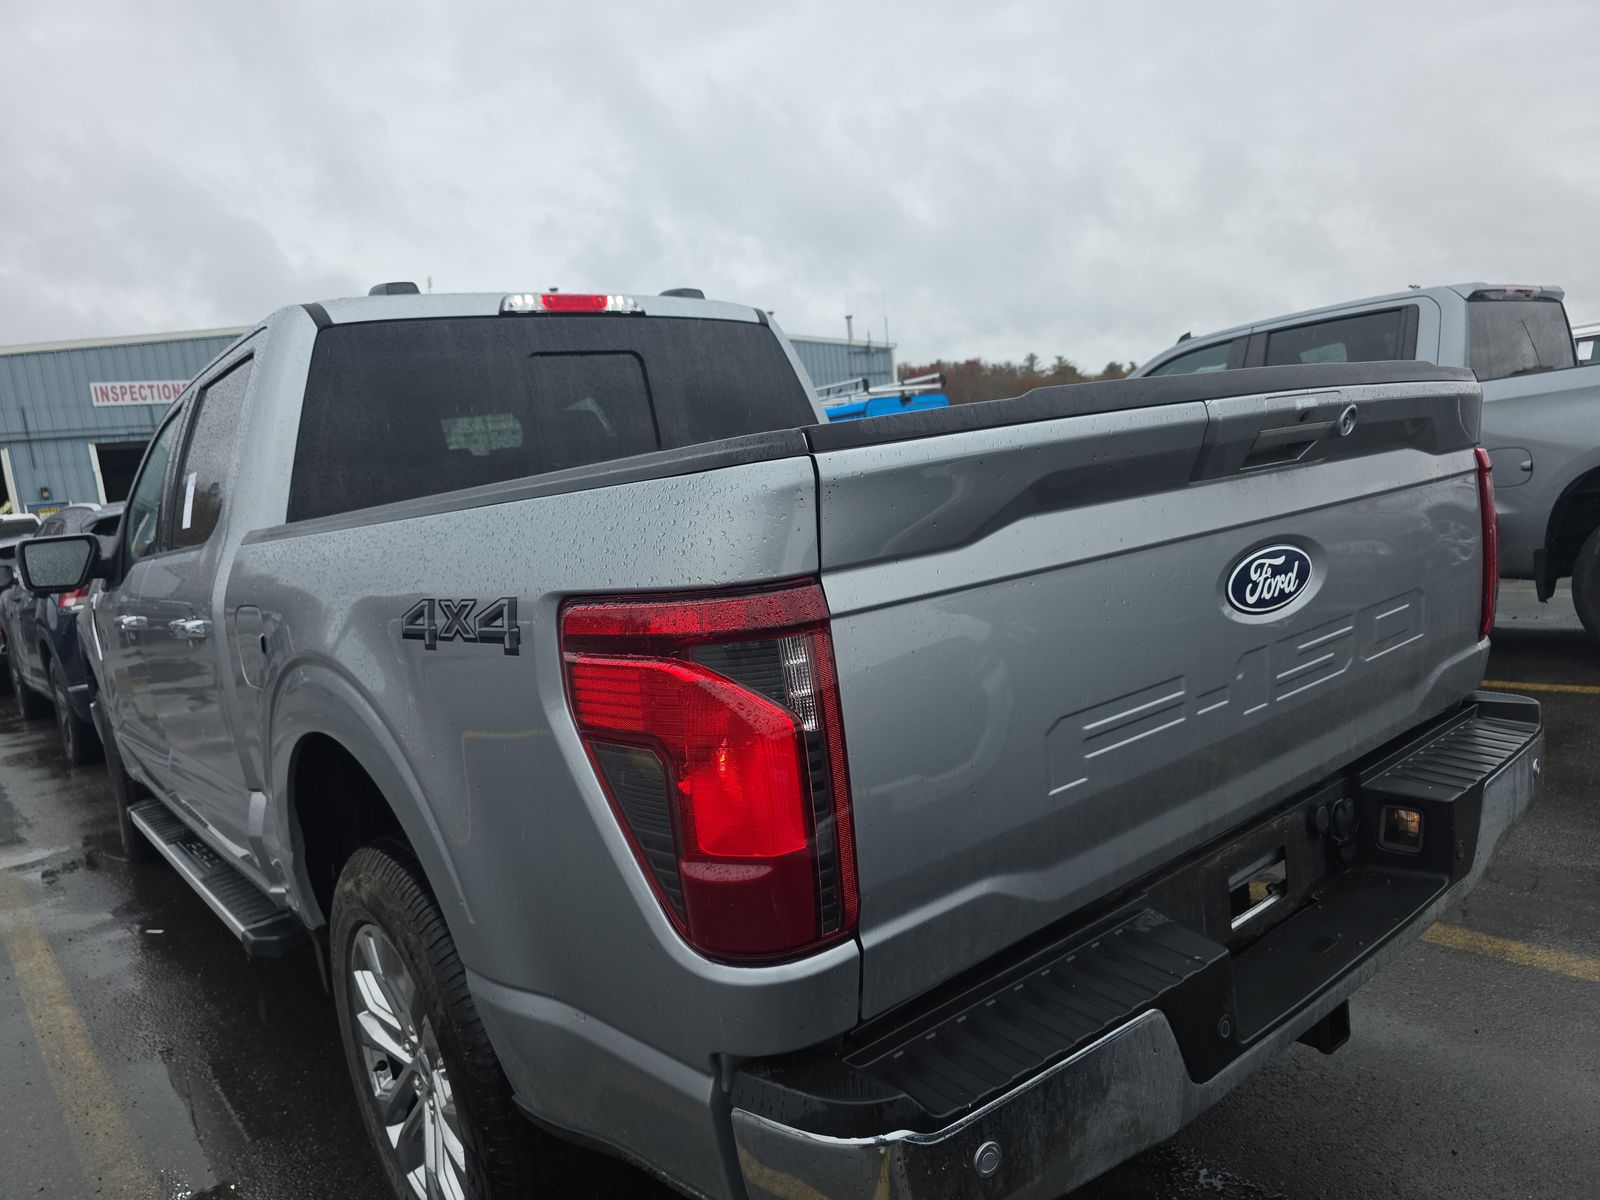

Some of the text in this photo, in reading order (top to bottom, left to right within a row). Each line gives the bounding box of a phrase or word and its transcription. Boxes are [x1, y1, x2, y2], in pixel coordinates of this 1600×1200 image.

[94, 383, 188, 403] INSPECTION
[1245, 555, 1299, 605] Ford
[1046, 588, 1426, 796] F-150
